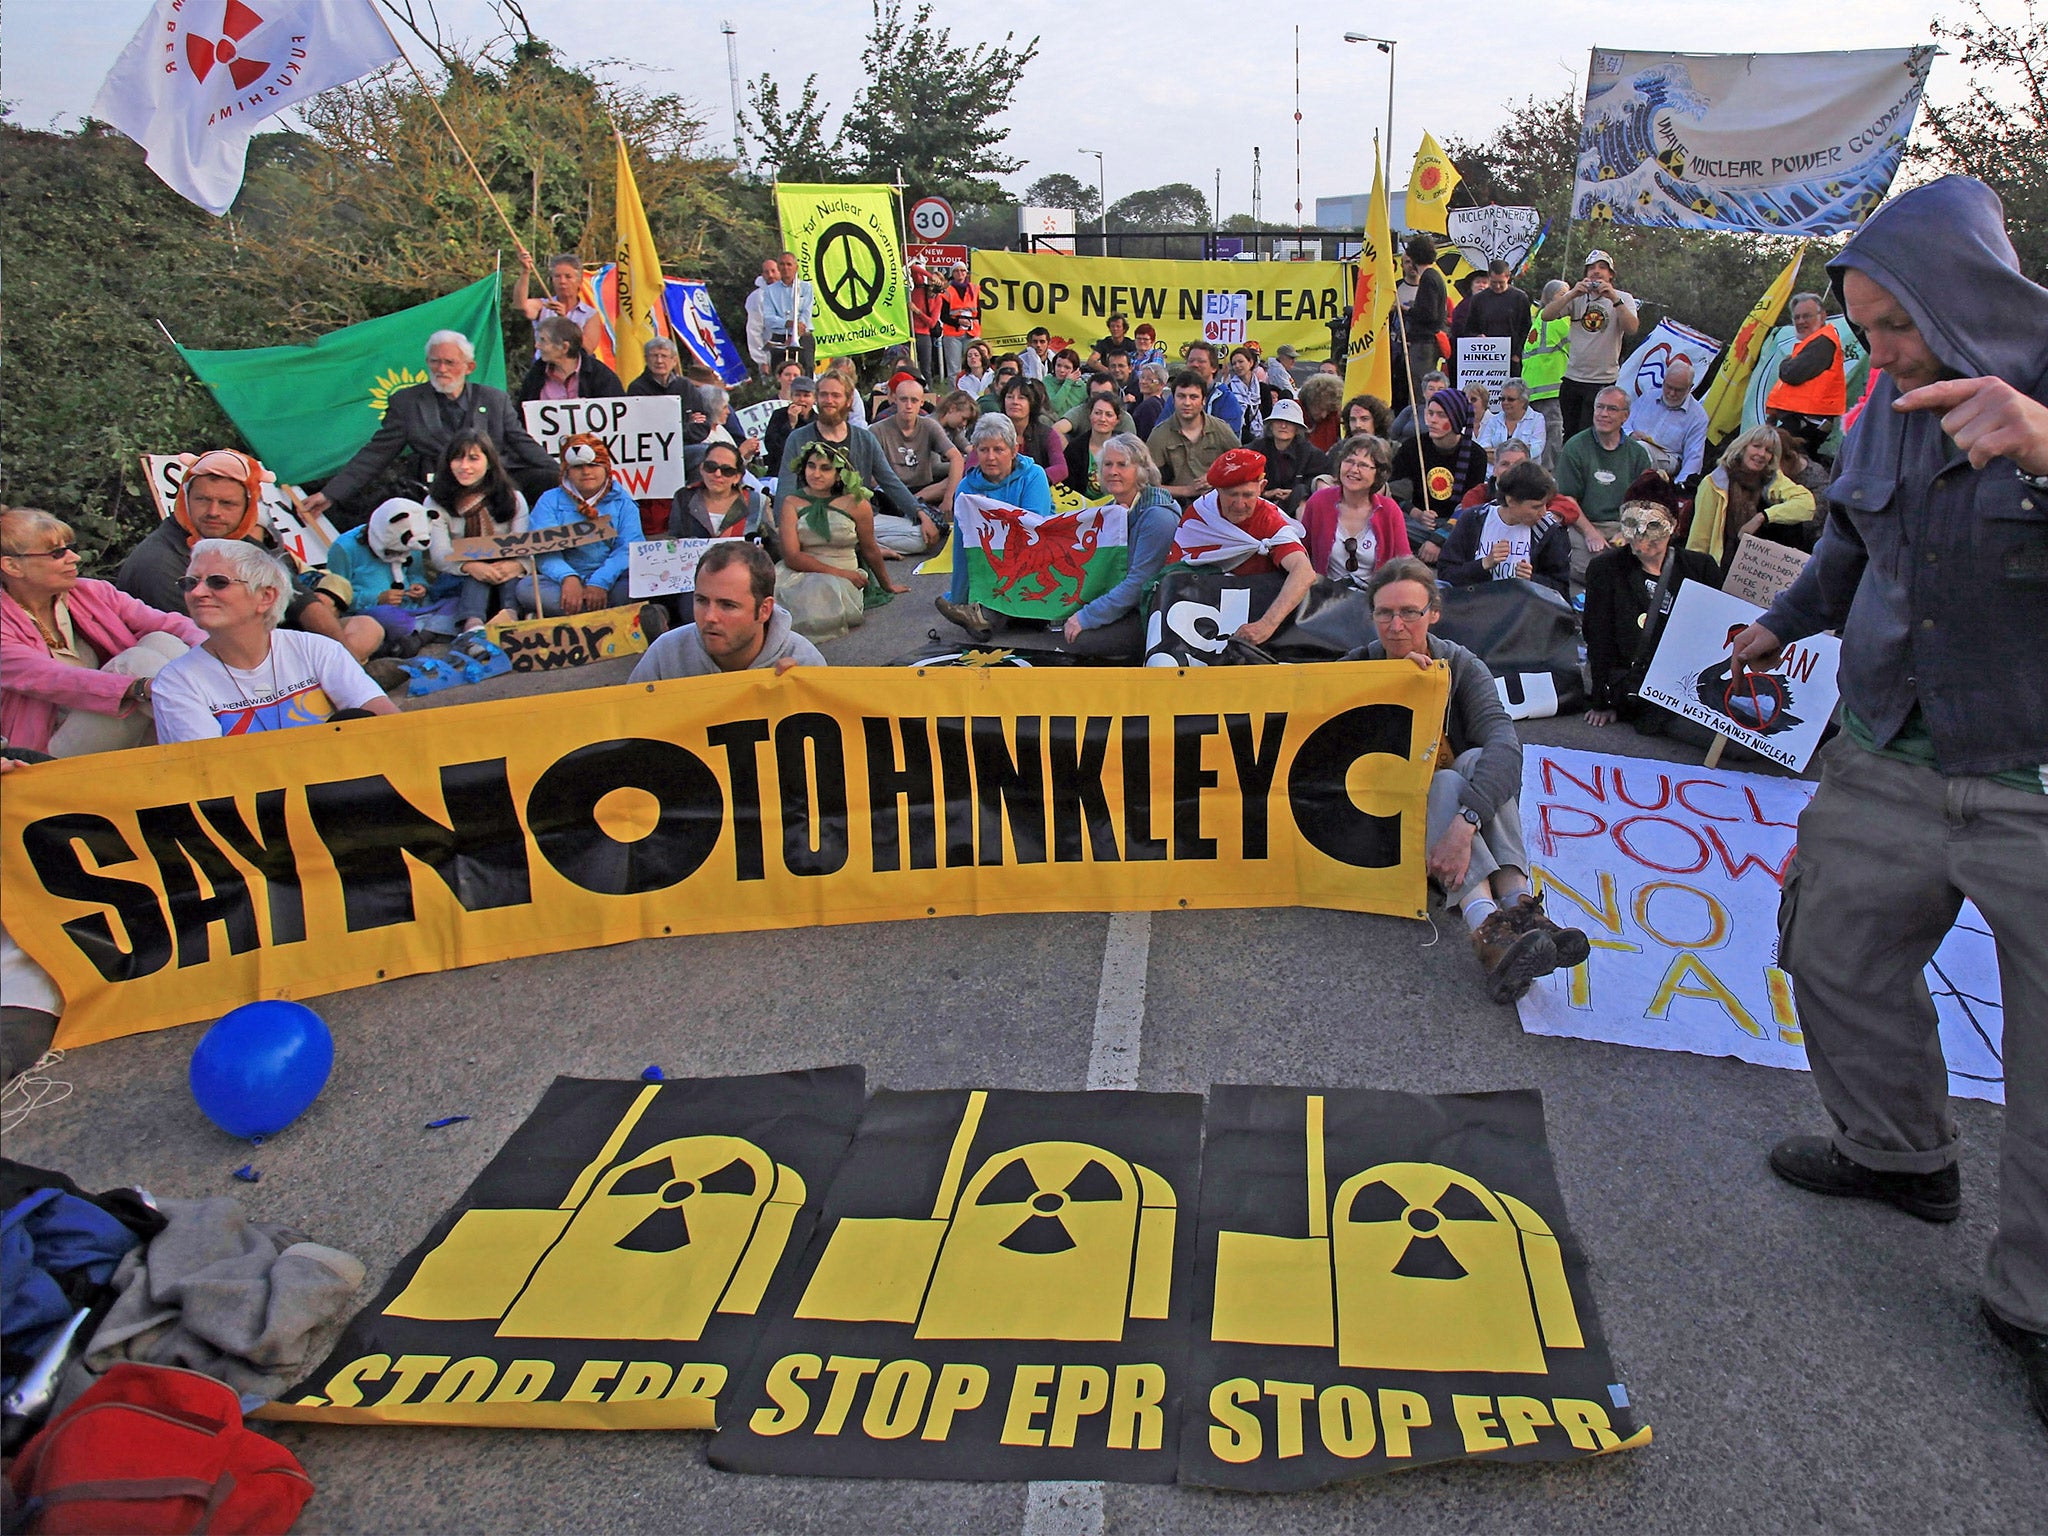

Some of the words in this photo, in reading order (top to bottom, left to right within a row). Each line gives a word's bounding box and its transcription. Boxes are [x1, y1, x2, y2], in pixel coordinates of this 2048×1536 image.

[1688, 155, 1764, 178] NUCLEAR
[1772, 146, 1842, 174] POWER
[1848, 84, 1922, 154] GOODBYE
[916, 211, 946, 229] 30
[1458, 208, 1495, 224] NUCLEAR
[803, 216, 817, 237] for
[816, 198, 863, 220] Nuclear
[869, 213, 898, 308] Disarmament
[925, 248, 944, 256] NEW
[931, 255, 963, 264] LAYOUT
[979, 276, 1070, 310] STOP
[1082, 284, 1168, 320] NEW
[1179, 288, 1339, 322] NLEAR
[1207, 294, 1243, 317] EDF
[1463, 353, 1507, 361] HINKLEY
[1470, 343, 1496, 352] STOP
[1460, 369, 1484, 377] BETTER
[1485, 369, 1508, 377] ACTIVE
[540, 401, 628, 436] STOP
[493, 521, 597, 547] WIND
[637, 542, 662, 556] STOP
[683, 538, 710, 548] NEW
[1732, 574, 1757, 589] THERE
[1761, 585, 1770, 594] IS
[1742, 587, 1757, 600] FOR
[222, 688, 287, 711] RENEWABLE
[1642, 685, 1679, 708] SOUTH
[1682, 703, 1712, 727] WEST
[1710, 717, 1753, 744] AGAINST
[1751, 732, 1797, 767] NUCLEAR
[22, 788, 307, 984] SAY
[304, 737, 724, 933] NO
[706, 711, 851, 882] TO
[861, 711, 1289, 874] HINKLEY
[1288, 703, 1415, 869] C
[1528, 862, 1734, 952] NO
[749, 1353, 990, 1442] STOP
[1000, 1362, 1168, 1450] EPR
[1208, 1377, 1432, 1465] STOP
[1452, 1394, 1623, 1455] EPR
